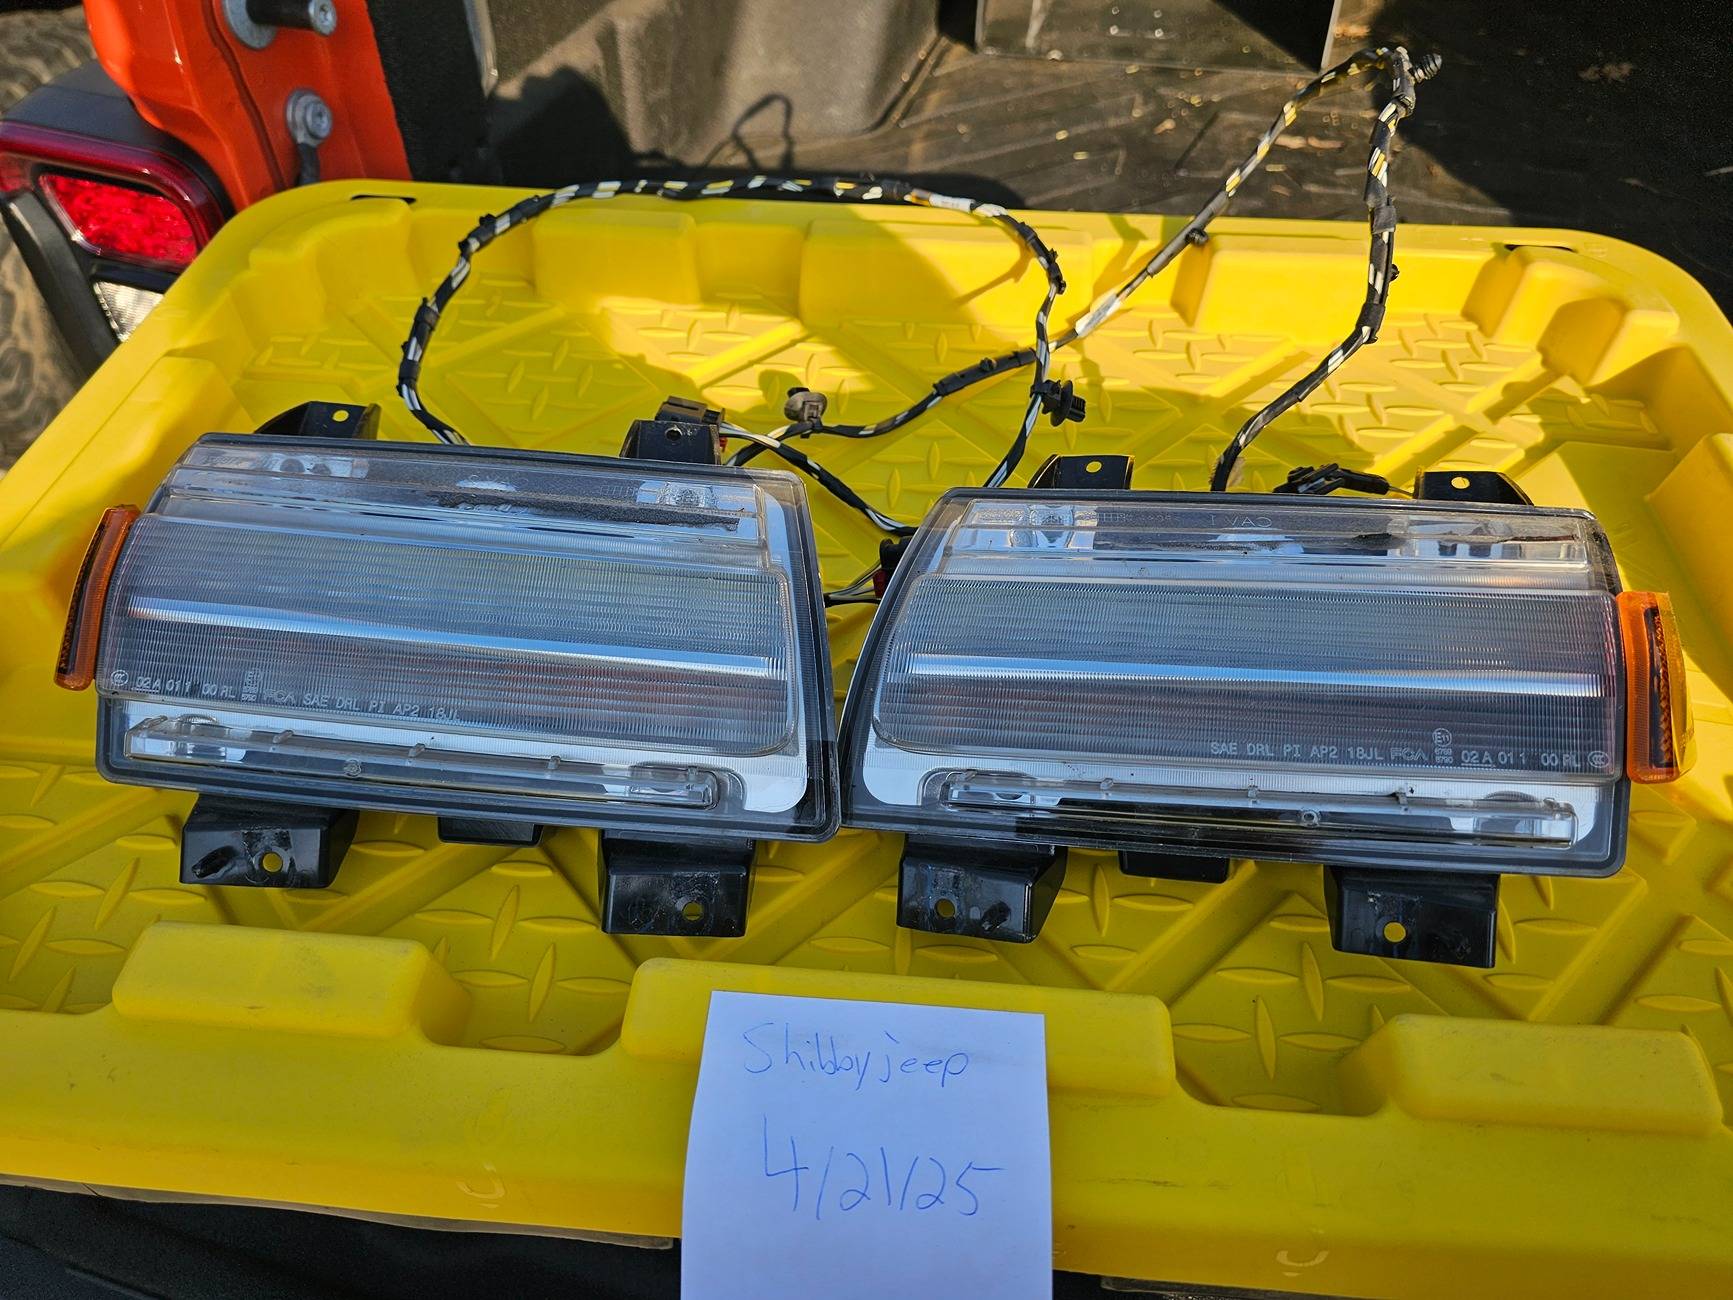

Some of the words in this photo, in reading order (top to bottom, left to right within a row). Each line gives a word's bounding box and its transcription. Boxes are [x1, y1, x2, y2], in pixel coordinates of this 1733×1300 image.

[302, 693, 329, 707] SAE
[335, 697, 360, 711] DRL
[392, 703, 420, 717] AP2
[1210, 742, 1238, 756] SAE
[1246, 743, 1274, 757] DRL
[1283, 744, 1300, 758] PI
[1310, 746, 1338, 759] AP2
[1348, 747, 1384, 761] 18JL
[763, 1112, 1005, 1221] 4/21/25
